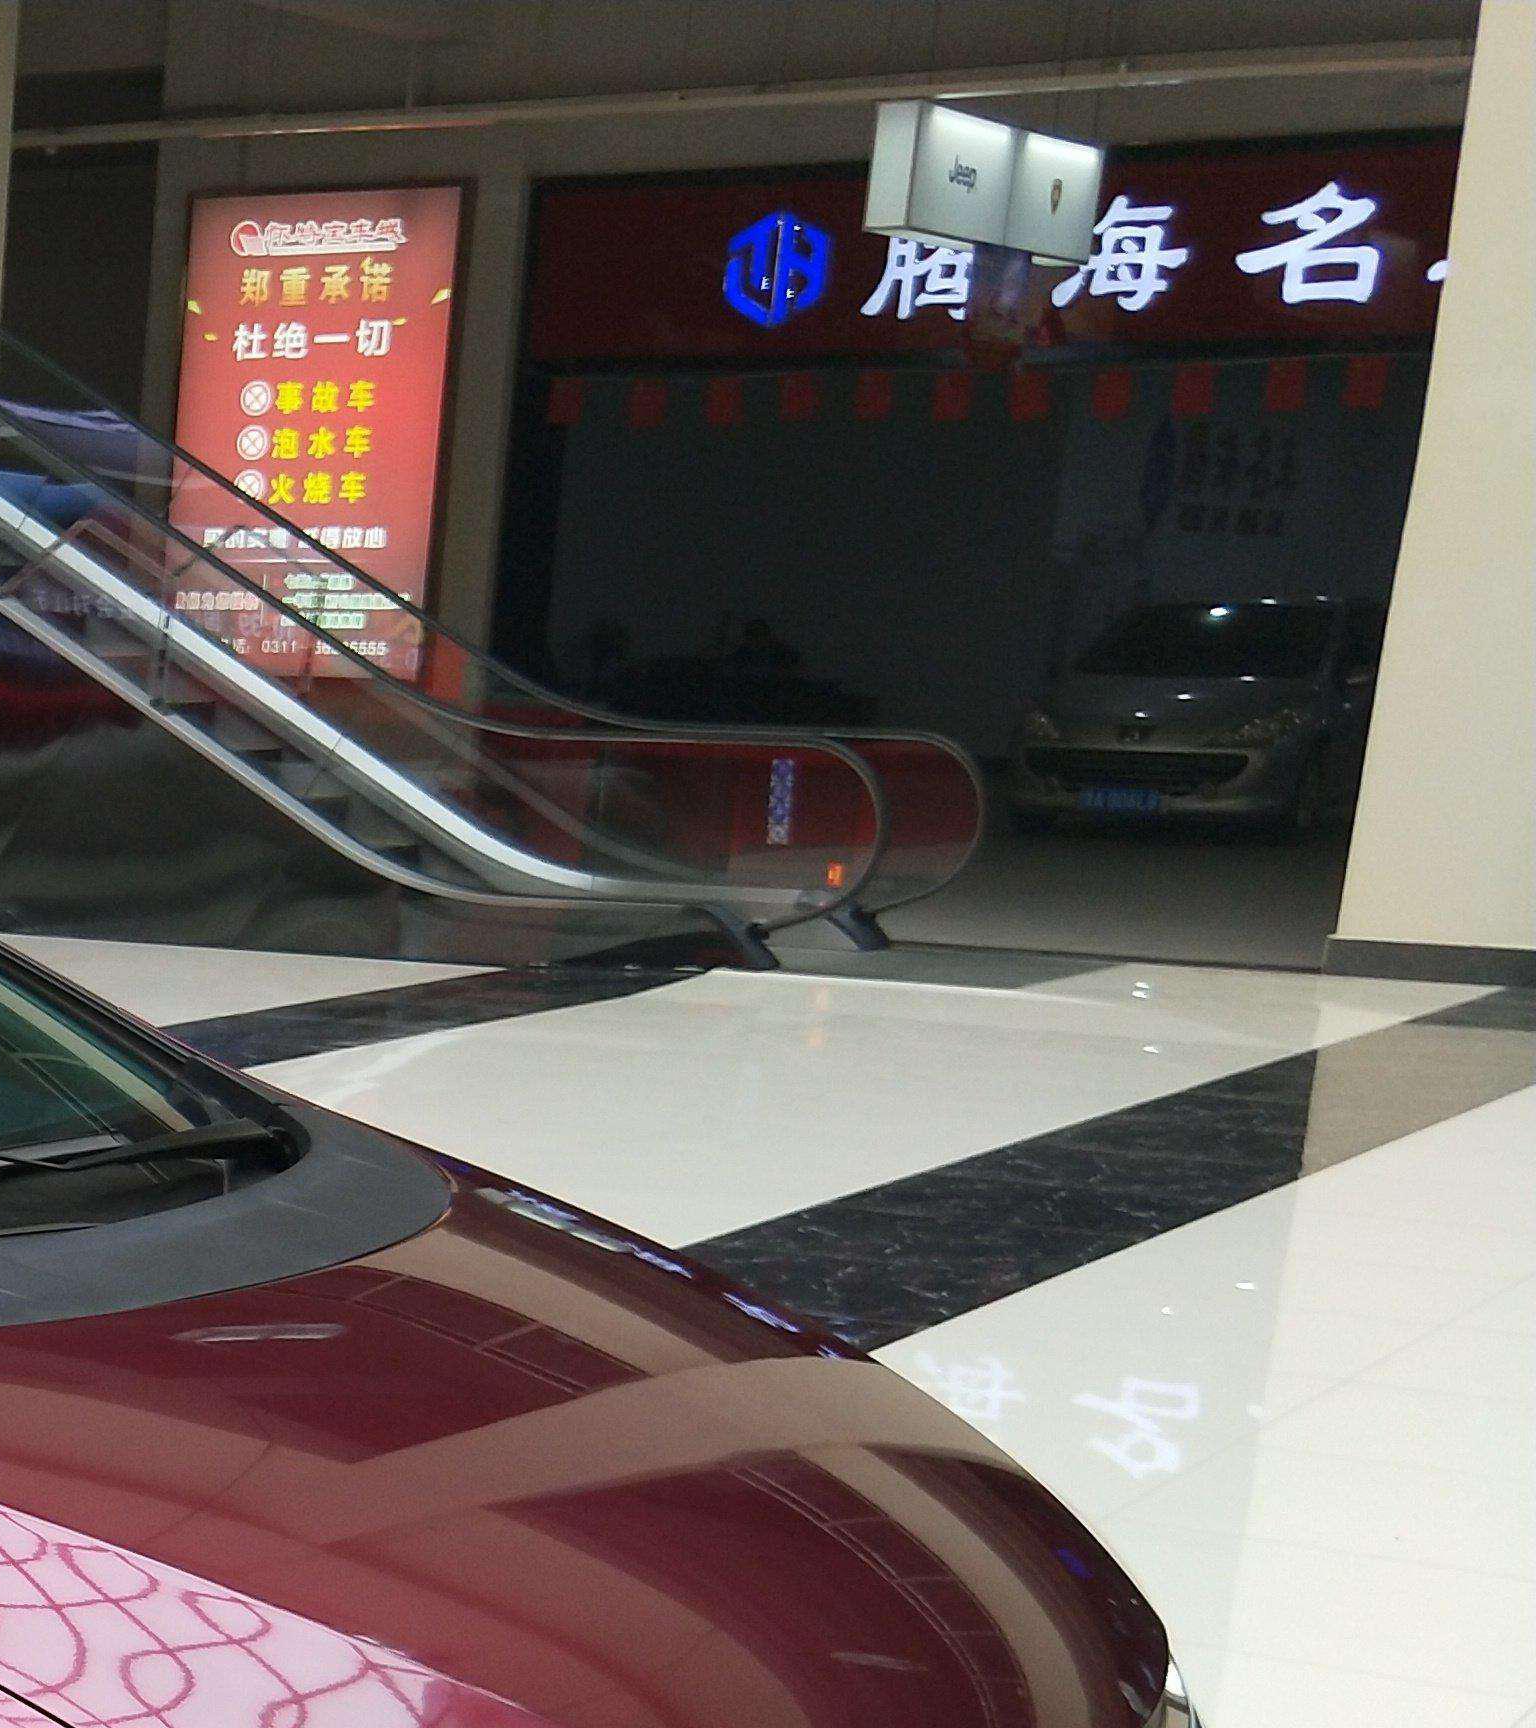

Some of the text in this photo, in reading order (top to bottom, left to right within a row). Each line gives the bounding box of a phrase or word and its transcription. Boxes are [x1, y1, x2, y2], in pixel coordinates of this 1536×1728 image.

[861, 181, 1448, 322] 腾海名
[240, 262, 394, 307] 郑重承诺
[232, 318, 394, 362] 杜绝一切
[274, 379, 377, 415] 事故车
[271, 425, 373, 460] 泡水车
[267, 471, 369, 505] 火烧车
